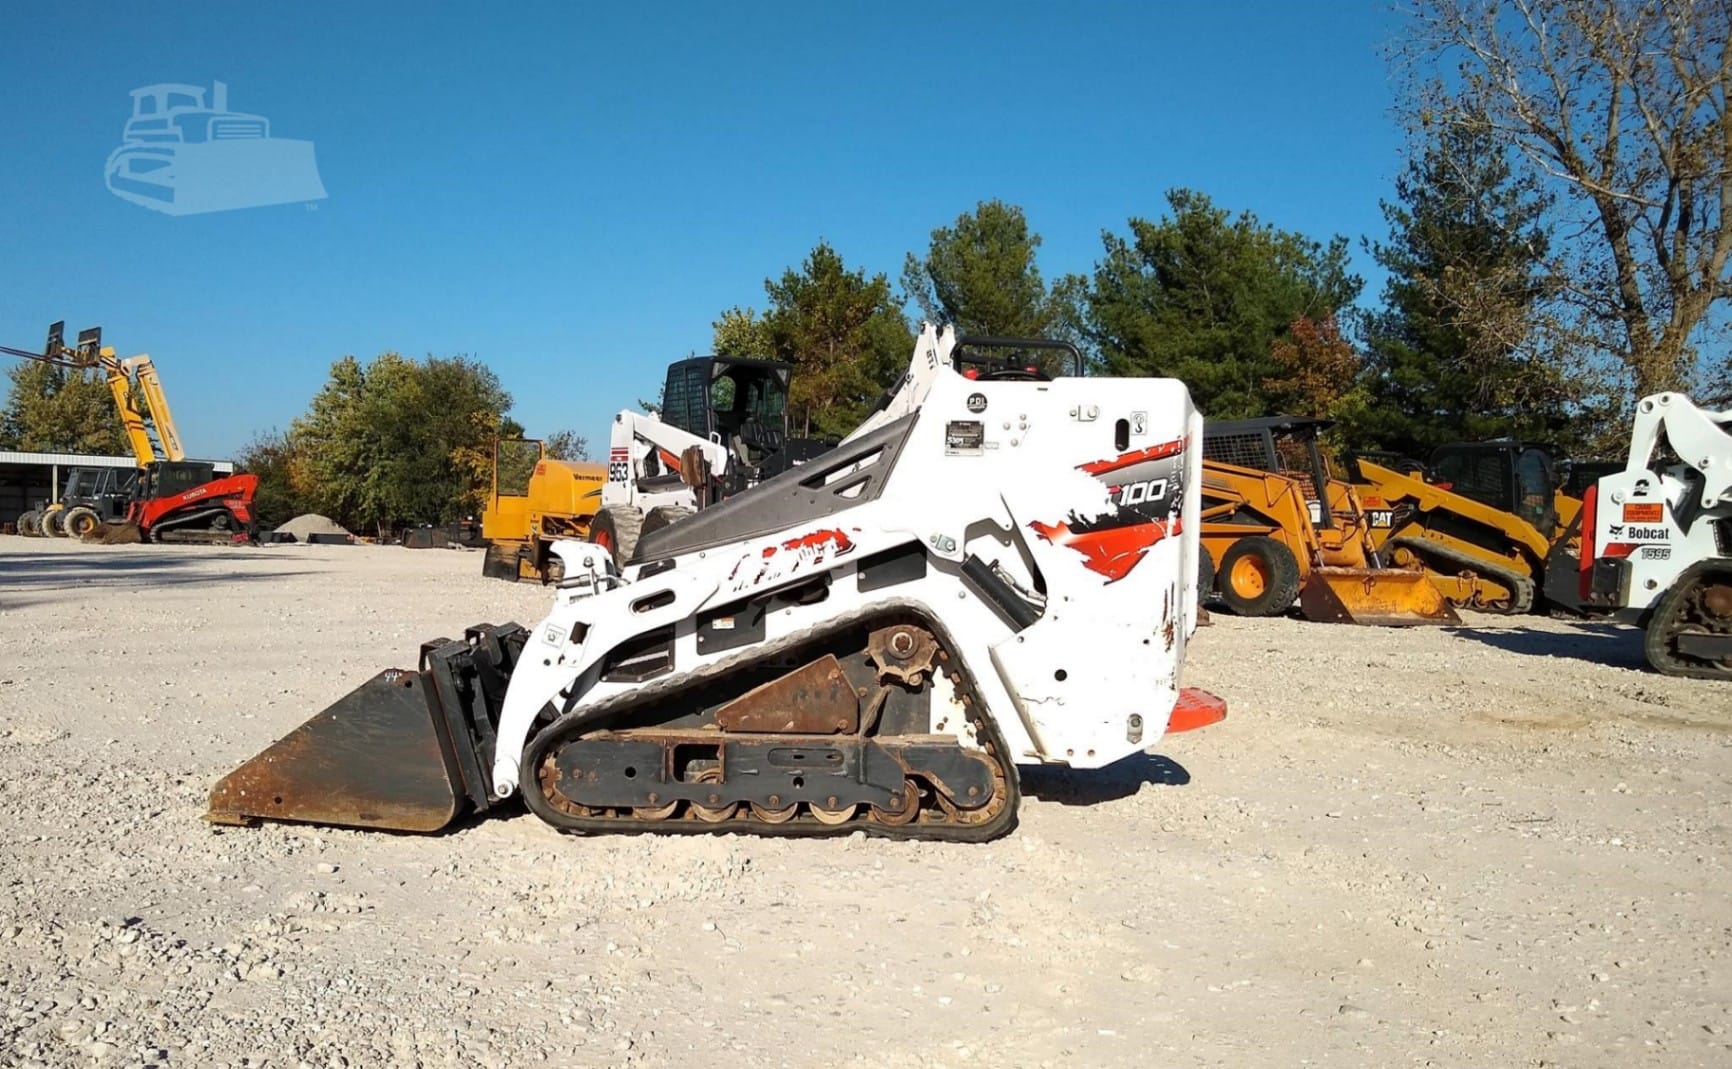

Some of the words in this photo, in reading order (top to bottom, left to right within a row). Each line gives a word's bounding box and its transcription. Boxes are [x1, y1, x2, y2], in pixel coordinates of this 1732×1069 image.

[182, 488, 207, 500] KUBOTA
[1371, 511, 1393, 527] CAT
[1628, 527, 1669, 539] Bobcat
[1641, 548, 1671, 560] T595
